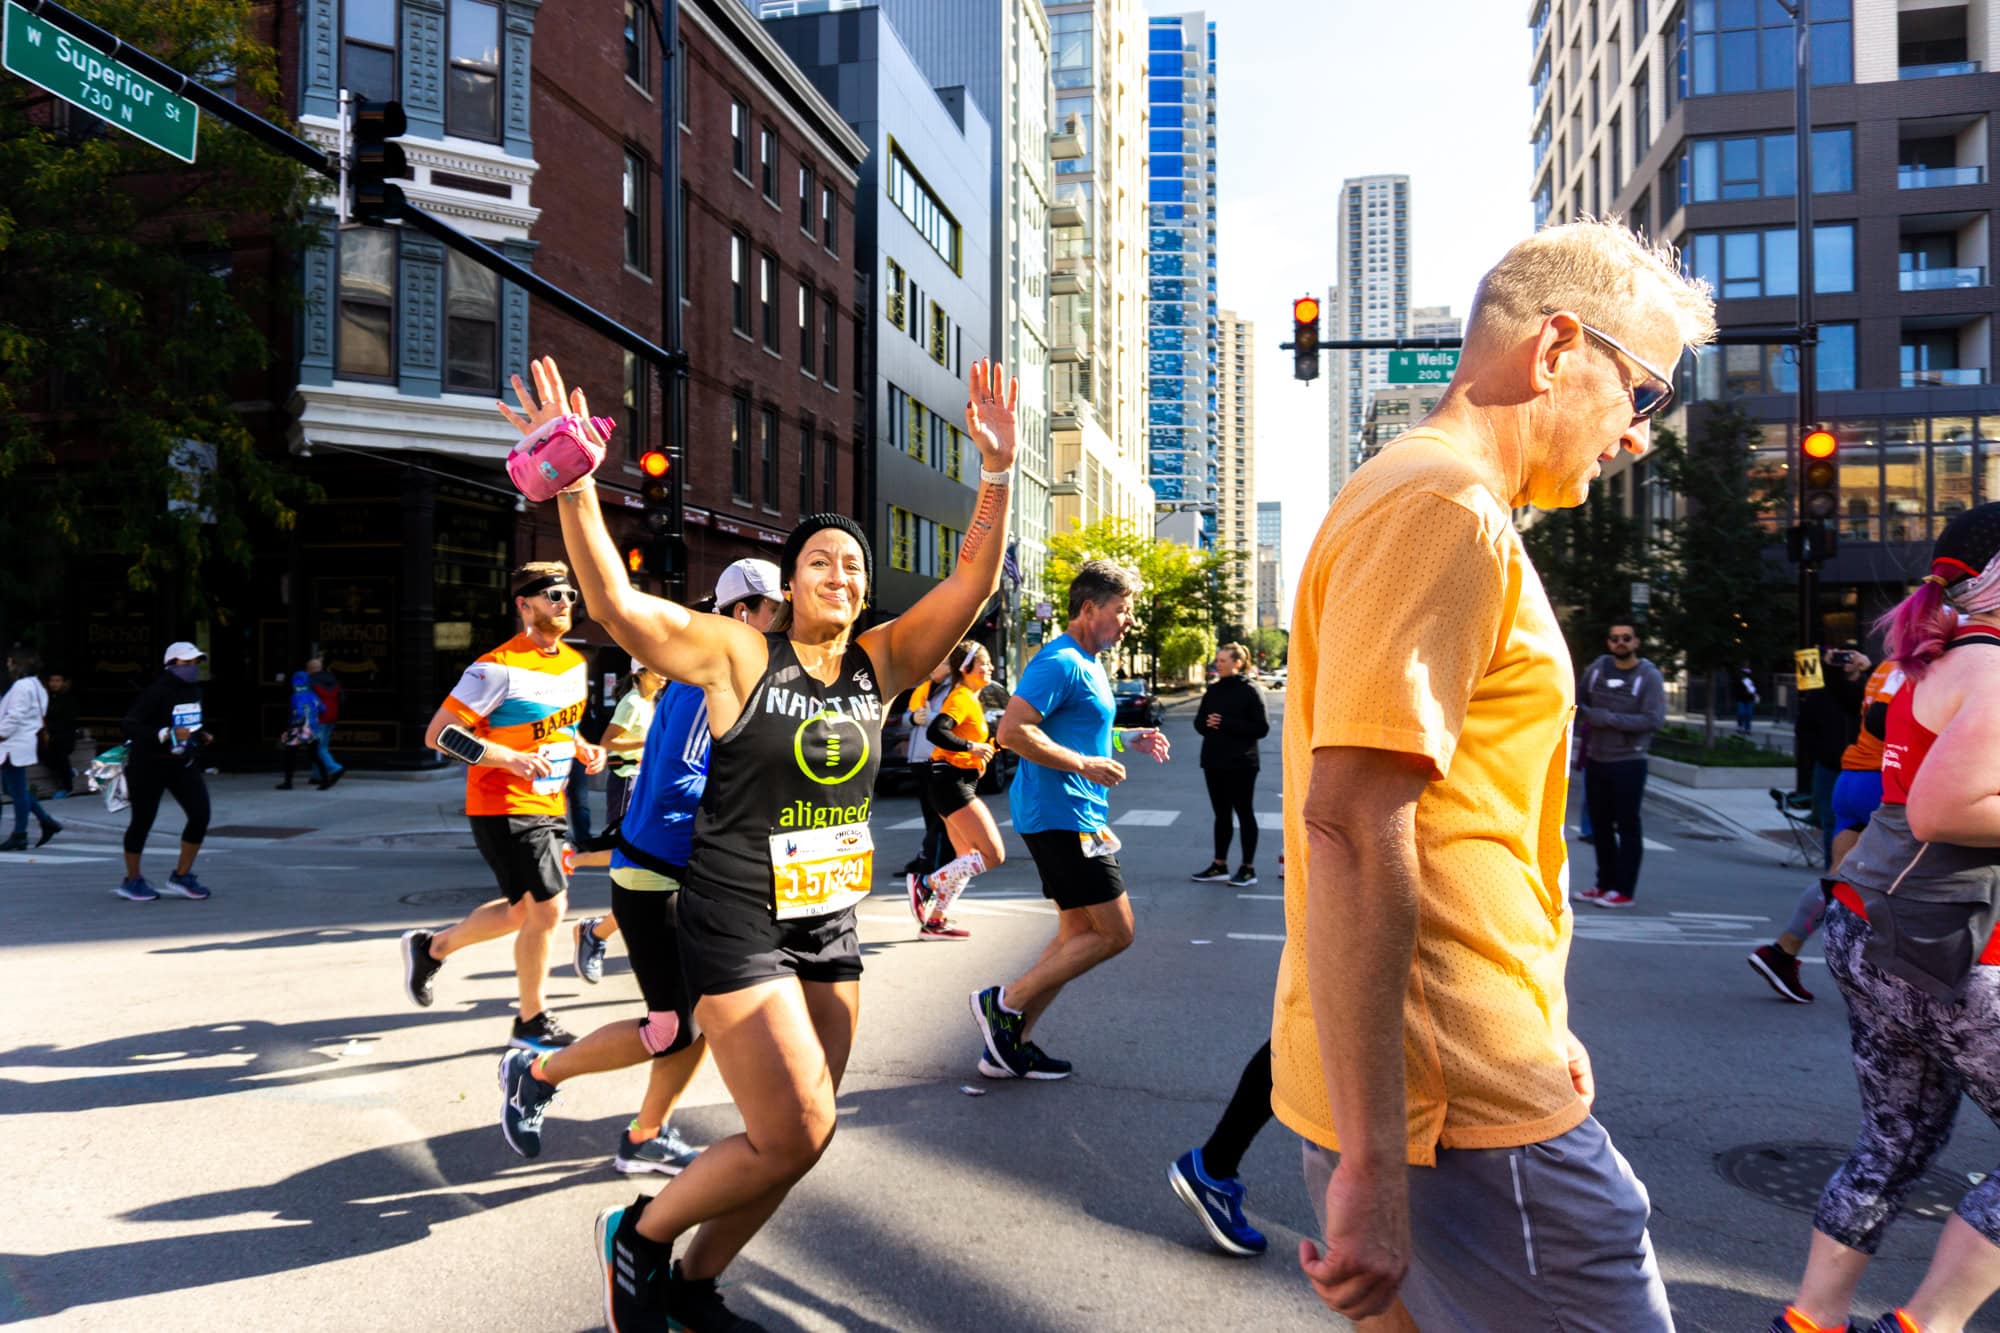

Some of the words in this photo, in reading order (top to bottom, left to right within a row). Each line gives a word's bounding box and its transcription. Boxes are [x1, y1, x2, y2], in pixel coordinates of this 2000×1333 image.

[27, 26, 41, 47] W
[56, 36, 154, 106] Superior
[165, 102, 181, 122] St
[79, 82, 112, 111] 730
[121, 104, 133, 122] N
[1400, 356, 1409, 366] N
[1416, 352, 1454, 366] Wells
[1418, 370, 1442, 380] 200
[1796, 658, 1817, 676] W
[766, 687, 881, 721] NADINE
[779, 797, 870, 830] aligned
